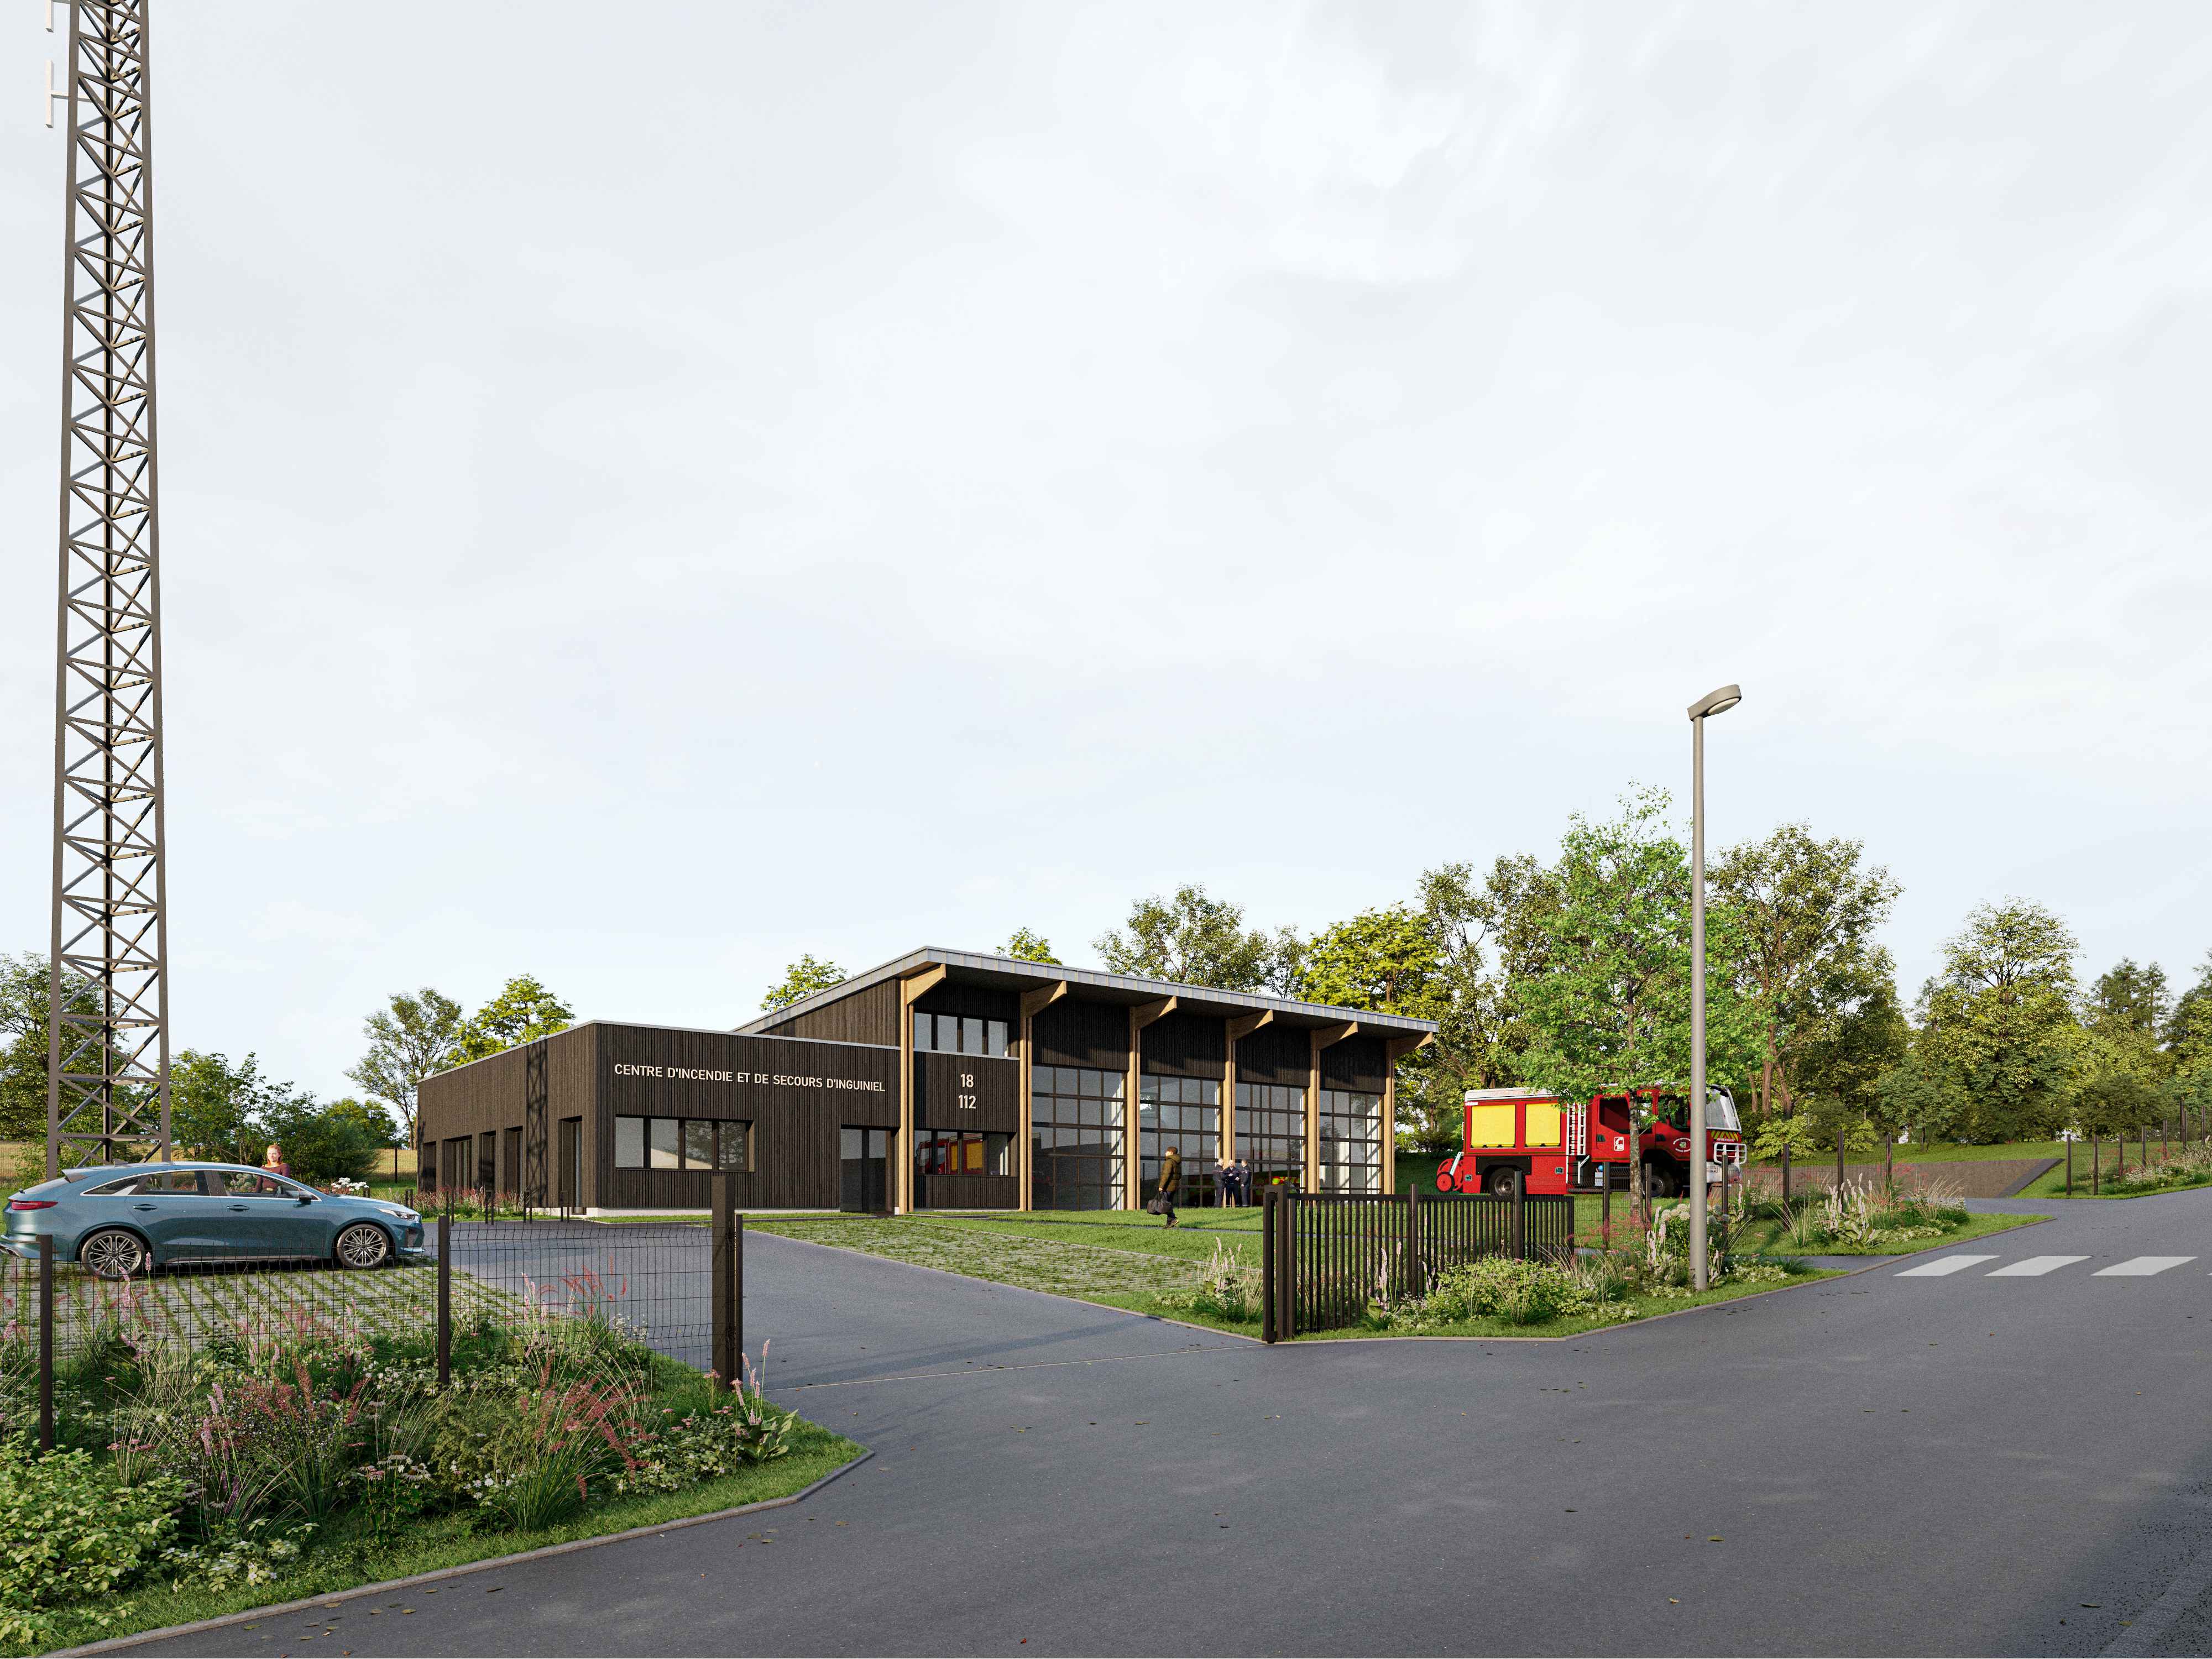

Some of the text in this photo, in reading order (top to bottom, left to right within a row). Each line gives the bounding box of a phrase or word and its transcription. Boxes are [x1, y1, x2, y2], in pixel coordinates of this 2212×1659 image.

[615, 1064, 886, 1092] CENTRE D'INCENDIE ET DE SECOURS D'INGUINIEL
[960, 1074, 974, 1088] 18
[959, 1095, 976, 1109] 112
